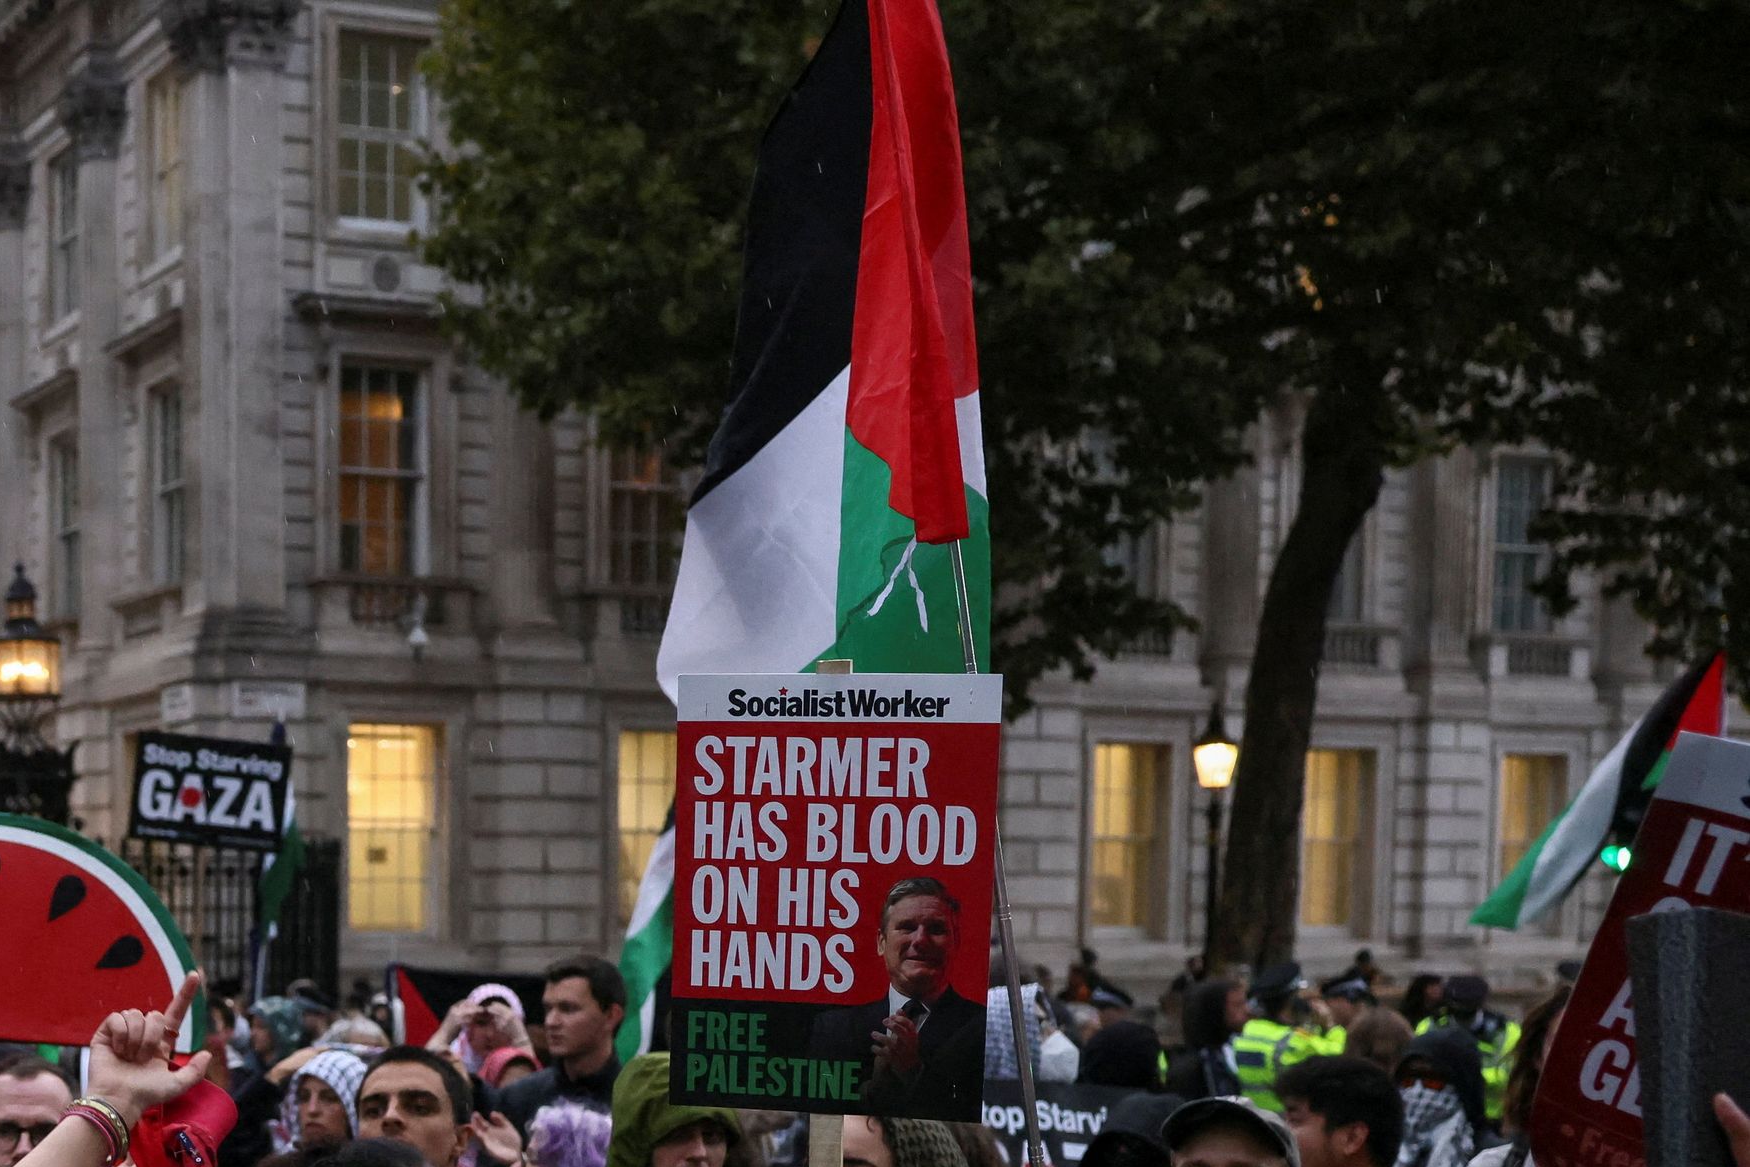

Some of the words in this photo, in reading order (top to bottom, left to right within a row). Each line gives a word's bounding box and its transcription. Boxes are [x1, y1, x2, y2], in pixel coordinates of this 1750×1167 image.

[144, 743, 192, 771] Stop
[196, 748, 283, 782] Starving
[694, 735, 930, 798] STARMER
[138, 768, 275, 833] GAZA
[693, 801, 788, 862] HAS
[806, 803, 977, 866] BLOOD
[691, 864, 759, 925] ON
[777, 868, 860, 929] HIS
[690, 930, 855, 994] HANDS
[687, 1010, 768, 1051] FREE
[685, 1053, 862, 1100] PALESTINE
[982, 1100, 1025, 1136] top
